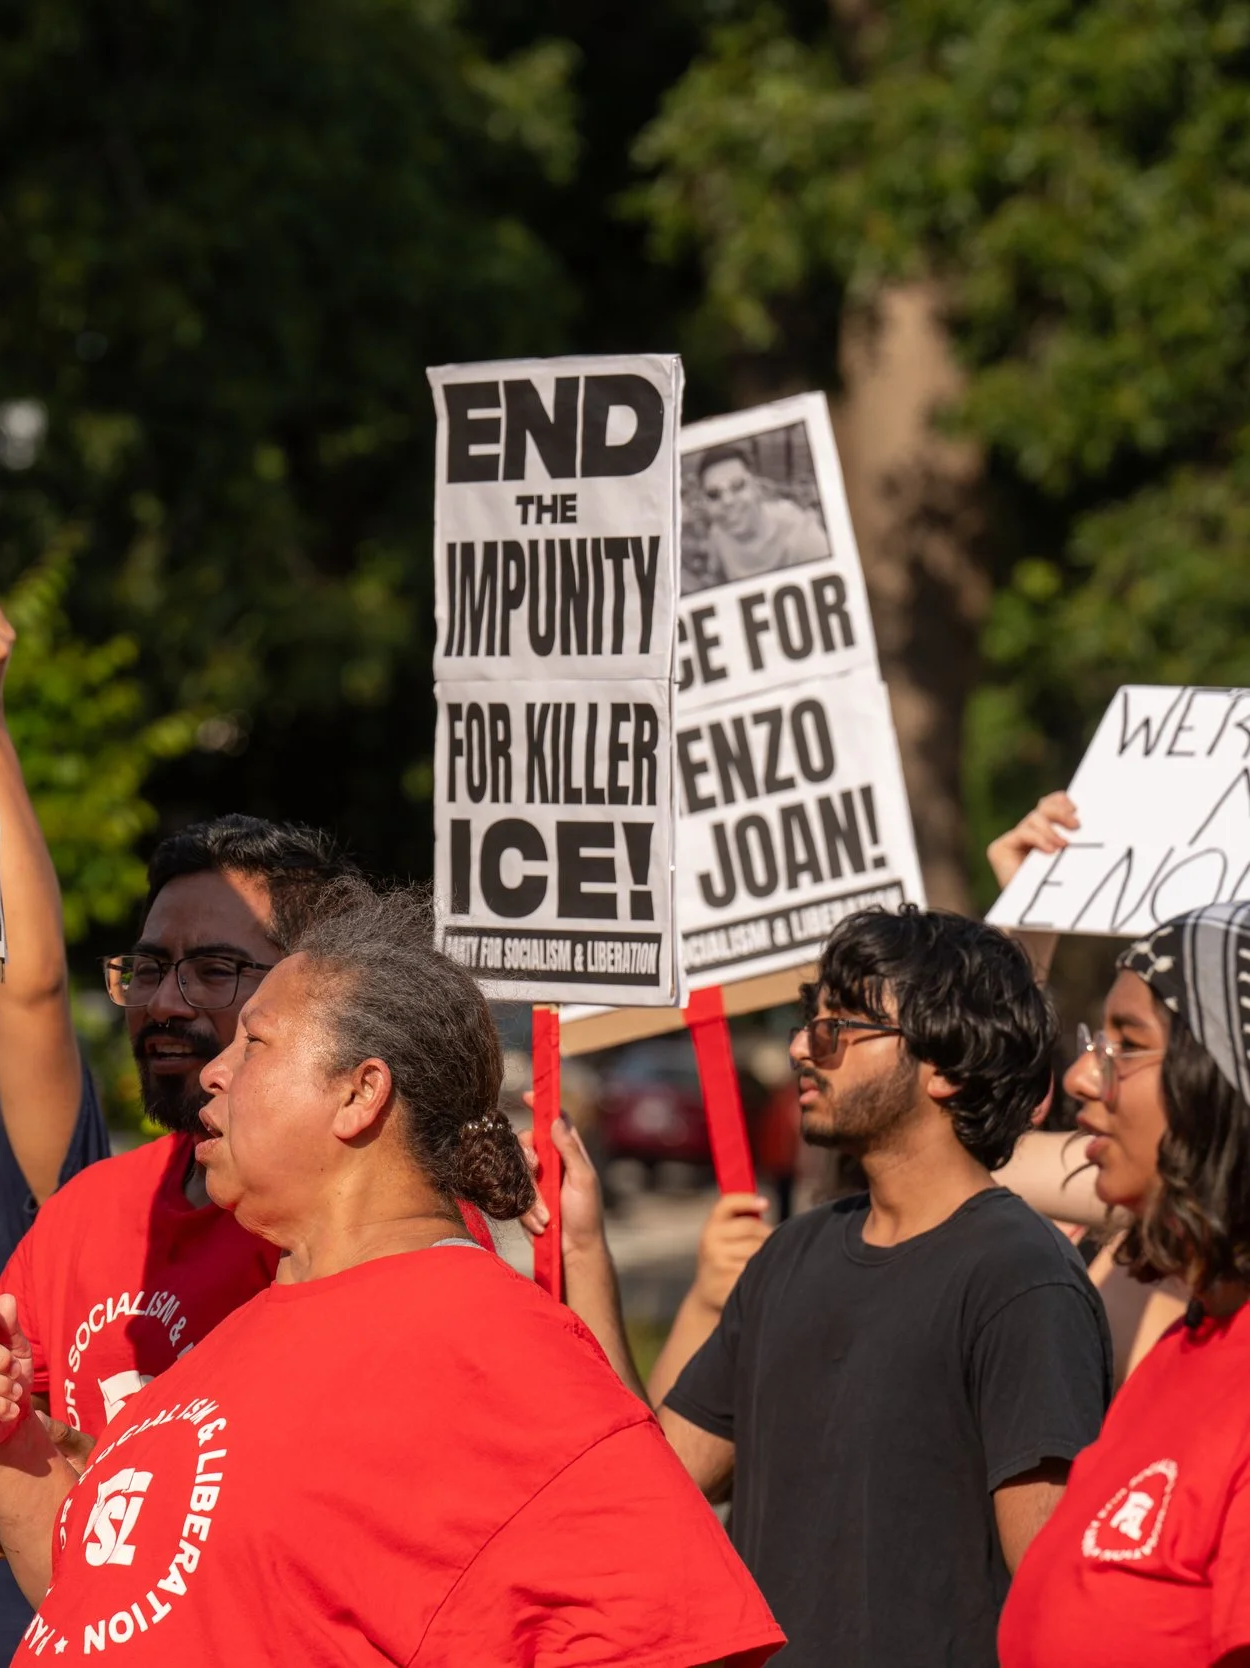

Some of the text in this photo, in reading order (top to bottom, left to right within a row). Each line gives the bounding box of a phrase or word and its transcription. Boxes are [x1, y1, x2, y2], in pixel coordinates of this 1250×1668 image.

[442, 374, 664, 483] END
[515, 493, 578, 525] THE
[444, 536, 661, 657] IMPUNITY
[739, 573, 855, 671] FOR
[446, 702, 659, 806] FOR KILLER
[677, 699, 837, 817] ENZO
[450, 817, 655, 921] ICE!
[698, 784, 888, 909] JOAN!
[1018, 842, 1250, 934] ENO
[504, 937, 572, 972] SOCIALISM
[574, 943, 585, 972] &
[587, 941, 659, 975] LIBERATION
[68, 1291, 180, 1373] SOCIALISM
[169, 1316, 187, 1347] &
[197, 1417, 227, 1447] &
[83, 1448, 228, 1655] LIBERATION
